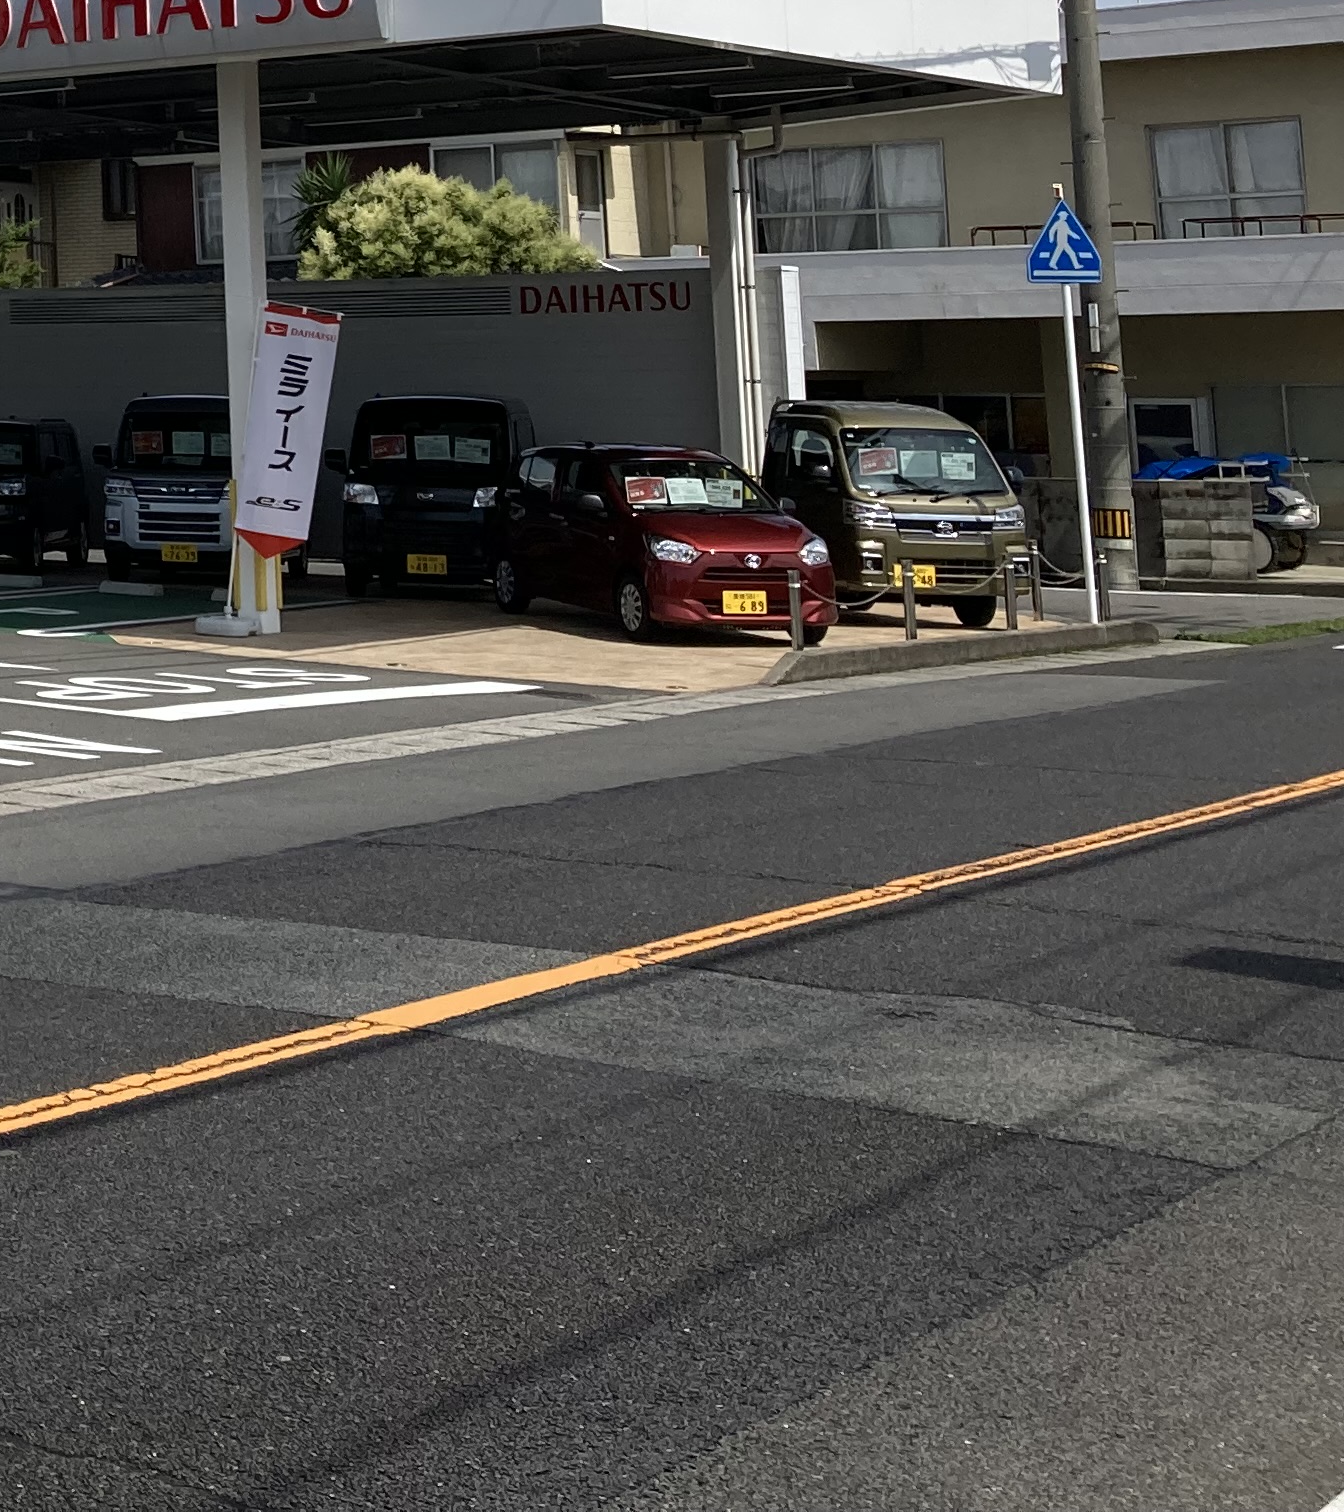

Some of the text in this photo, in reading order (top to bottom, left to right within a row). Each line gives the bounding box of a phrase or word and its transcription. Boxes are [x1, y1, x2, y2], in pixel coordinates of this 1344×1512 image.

[519, 280, 692, 315] DAIHATSU
[290, 327, 337, 343] DAIHATSU
[267, 353, 314, 473] ミライース
[14, 667, 372, 701] STOP
